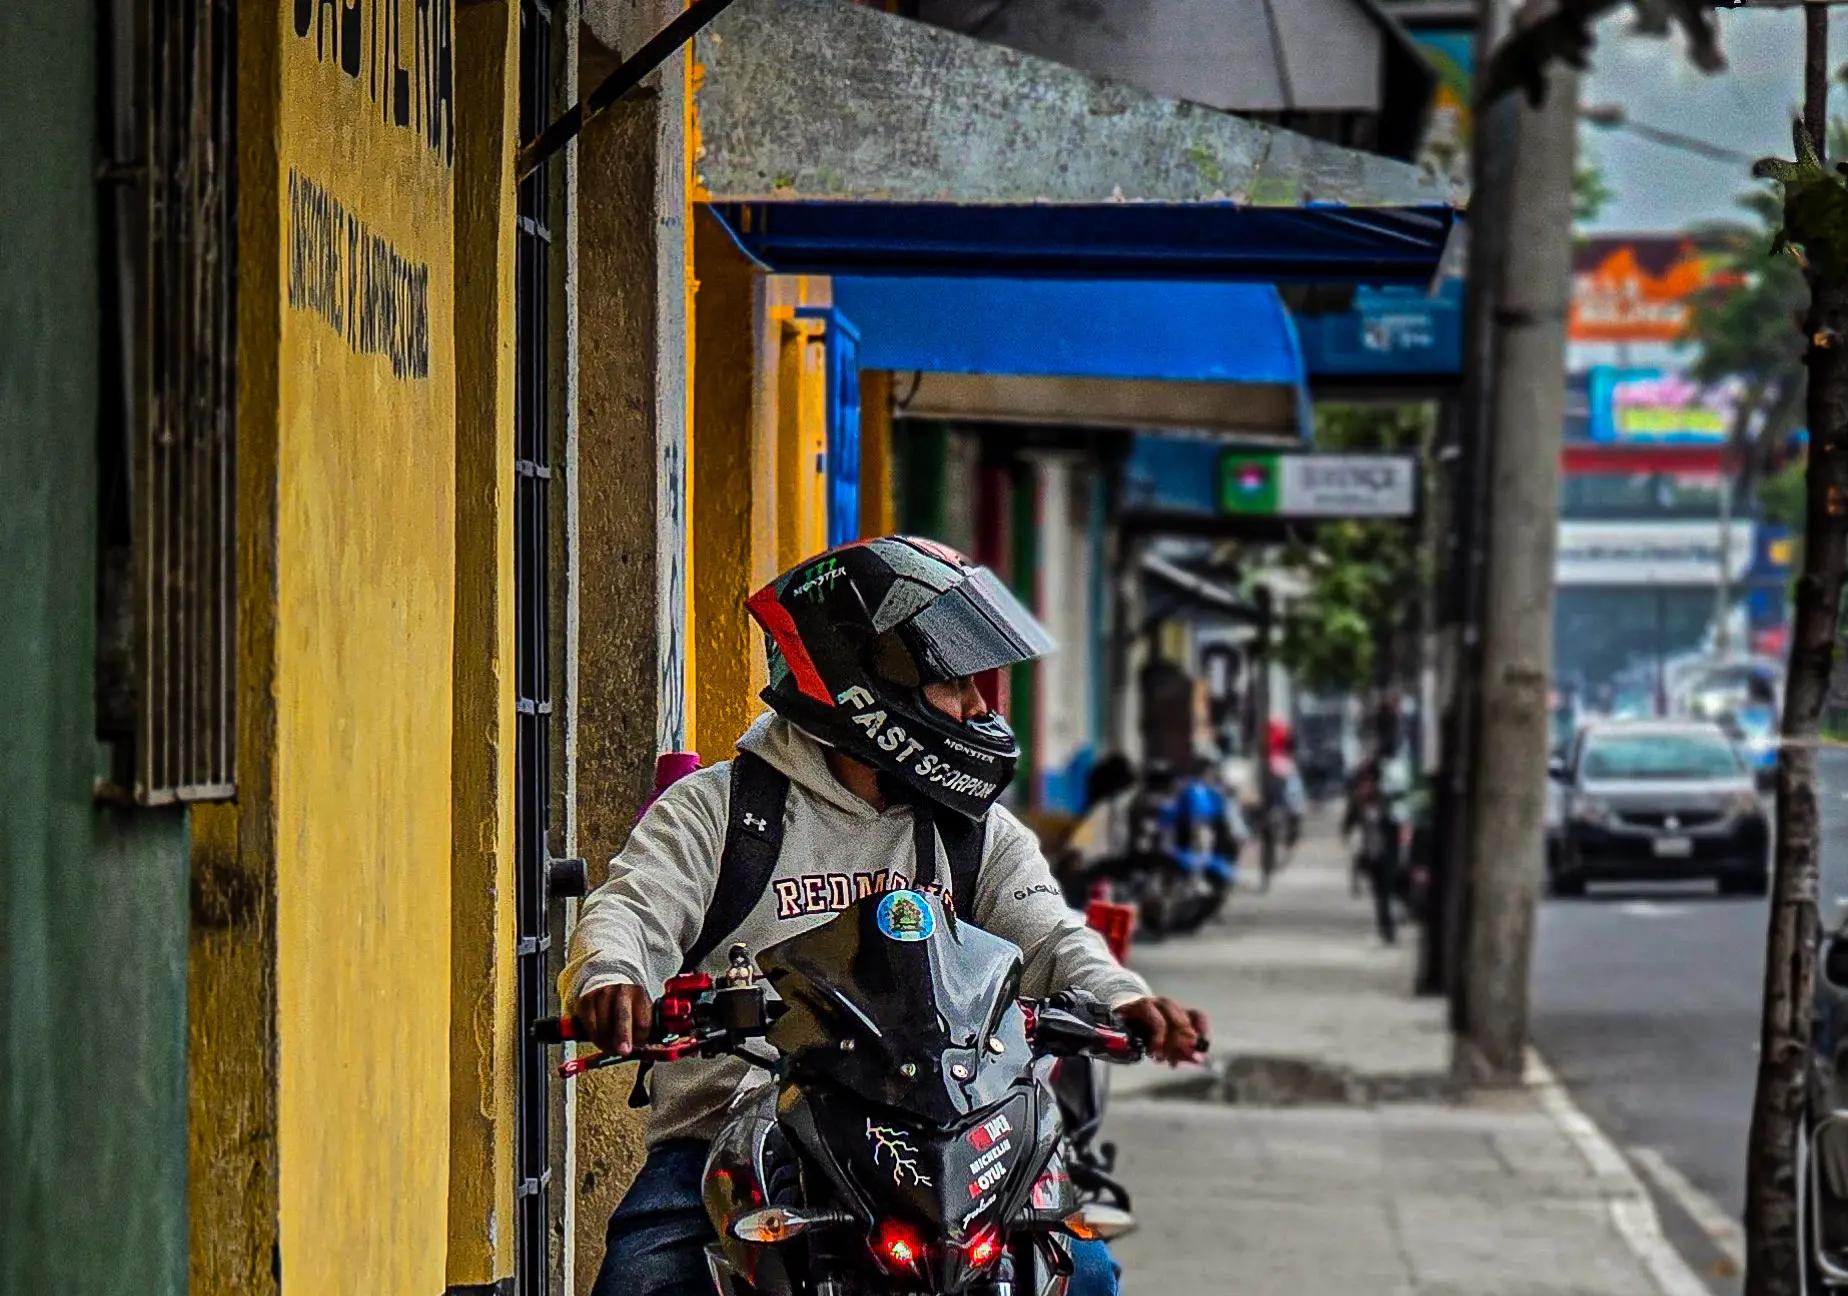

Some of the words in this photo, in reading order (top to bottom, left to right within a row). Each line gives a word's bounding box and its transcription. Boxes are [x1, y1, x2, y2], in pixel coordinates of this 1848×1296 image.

[836, 685, 925, 763] FAST
[914, 754, 997, 799] SCORPION
[969, 1138, 1012, 1175] MICHELIN
[968, 1161, 1007, 1199] MOTUL
